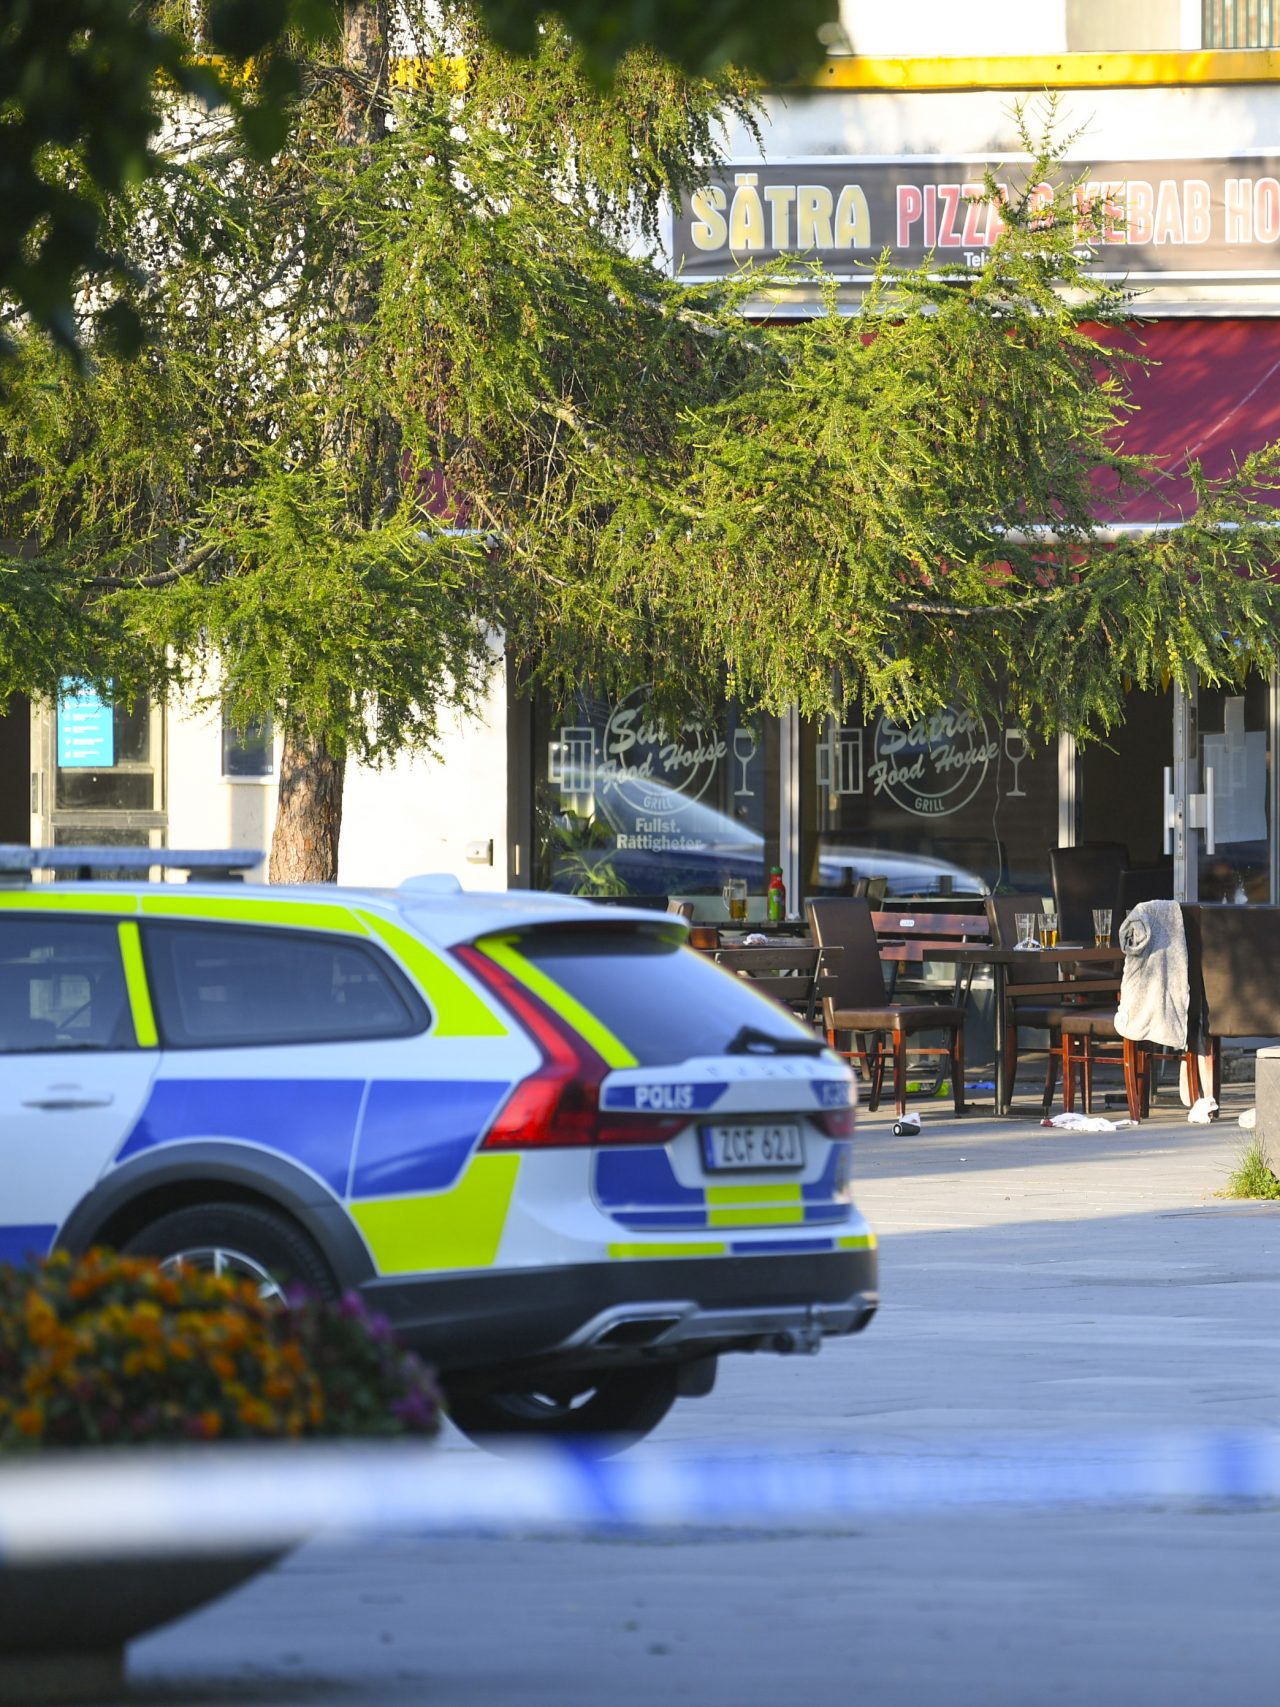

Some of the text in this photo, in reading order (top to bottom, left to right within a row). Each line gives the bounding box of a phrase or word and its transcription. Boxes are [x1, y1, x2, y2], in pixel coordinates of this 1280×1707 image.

[691, 173, 871, 250] SÄTRA
[897, 183, 1012, 248] PIZZA
[1072, 180, 1211, 246] KEBAB
[597, 741, 727, 794] Food House
[868, 742, 999, 795] Food House
[643, 797, 673, 810] GRILL
[915, 797, 944, 811] GRILL
[636, 818, 681, 833] Fullst.
[617, 834, 703, 852] Rättigheter
[635, 1084, 694, 1109] POLIS
[720, 1129, 754, 1162] ZCF
